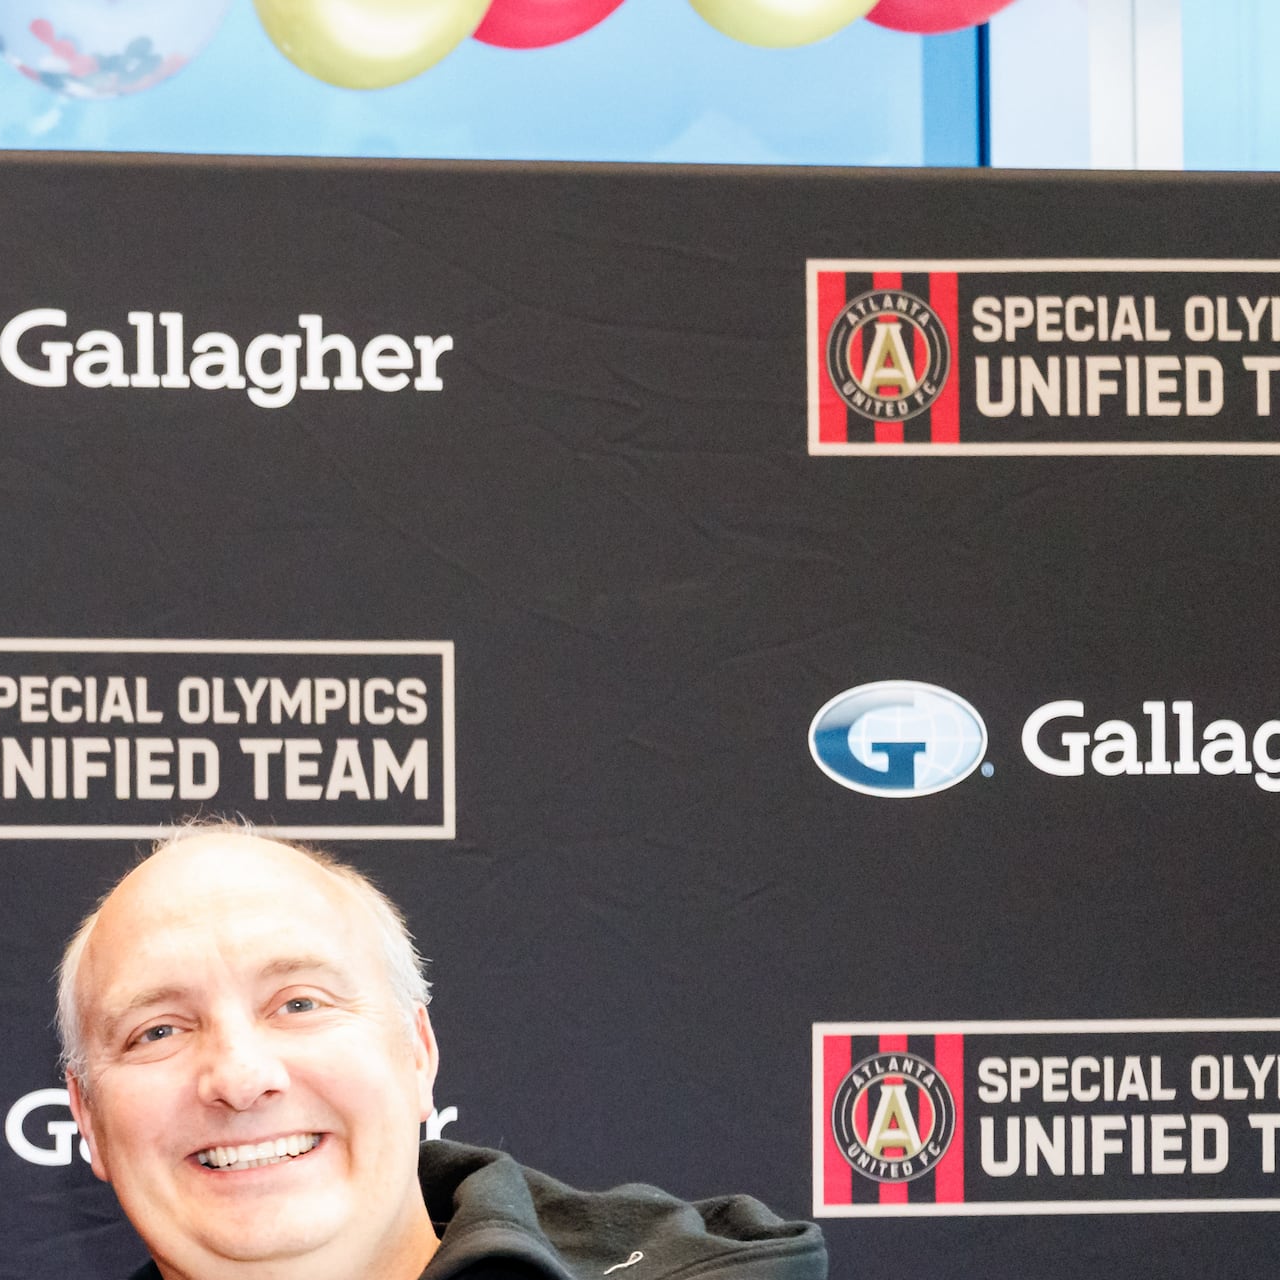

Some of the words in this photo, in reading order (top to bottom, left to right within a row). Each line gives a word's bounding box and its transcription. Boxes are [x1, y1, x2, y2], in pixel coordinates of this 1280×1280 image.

[846, 294, 931, 327] ATLANTA
[971, 295, 1171, 342] SPECIAL
[842, 380, 909, 417] UNITED
[913, 381, 937, 406] FC
[974, 355, 1224, 417] UNIFIED
[177, 676, 428, 725] OLYMPICS
[240, 737, 429, 801] TEAM
[852, 1056, 935, 1089] ATLANTA
[977, 1054, 1177, 1103] SPECIAL
[847, 1142, 913, 1178] UNITED
[919, 1141, 941, 1167] FC
[979, 1113, 1229, 1178] UNIFIED
